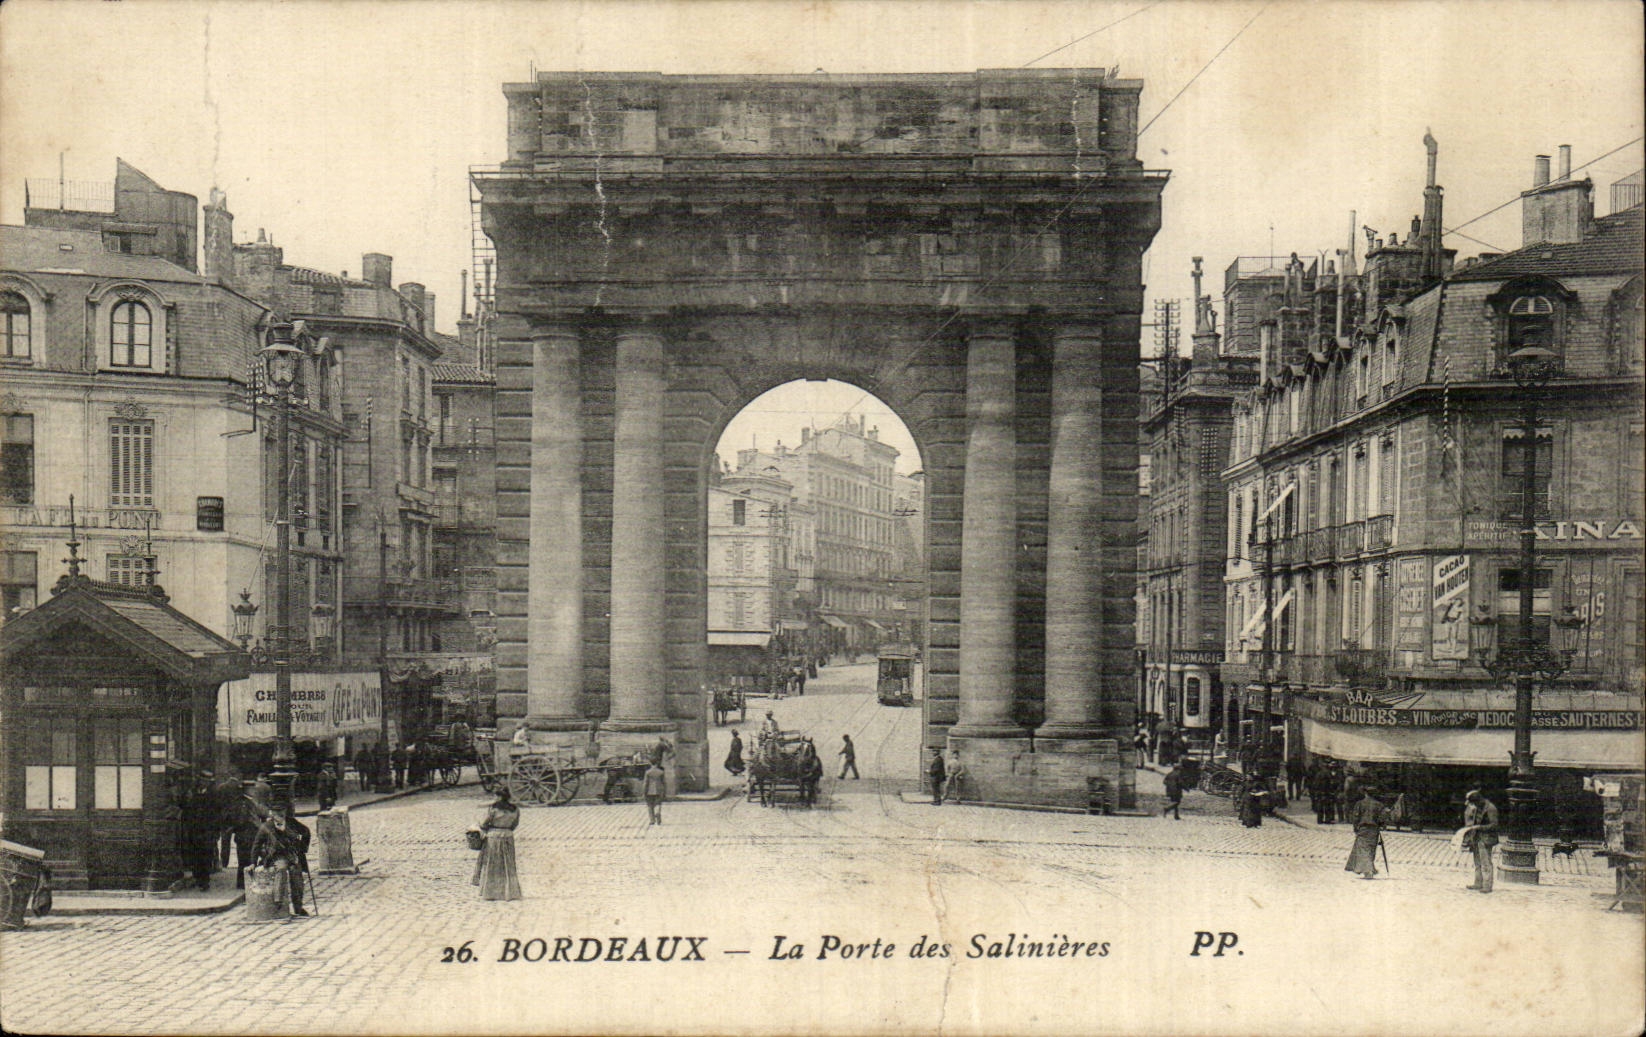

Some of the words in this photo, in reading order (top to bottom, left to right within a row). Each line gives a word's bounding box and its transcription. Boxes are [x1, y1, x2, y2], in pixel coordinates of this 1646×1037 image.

[1439, 554, 1465, 578] CACAO
[1434, 572, 1446, 601] VAN
[1446, 566, 1468, 594] HOUTEN
[256, 690, 326, 702] CHMBRES
[1346, 690, 1373, 707] BAR
[1412, 710, 1430, 726] VIN
[1560, 711, 1633, 727] SAUTERNES
